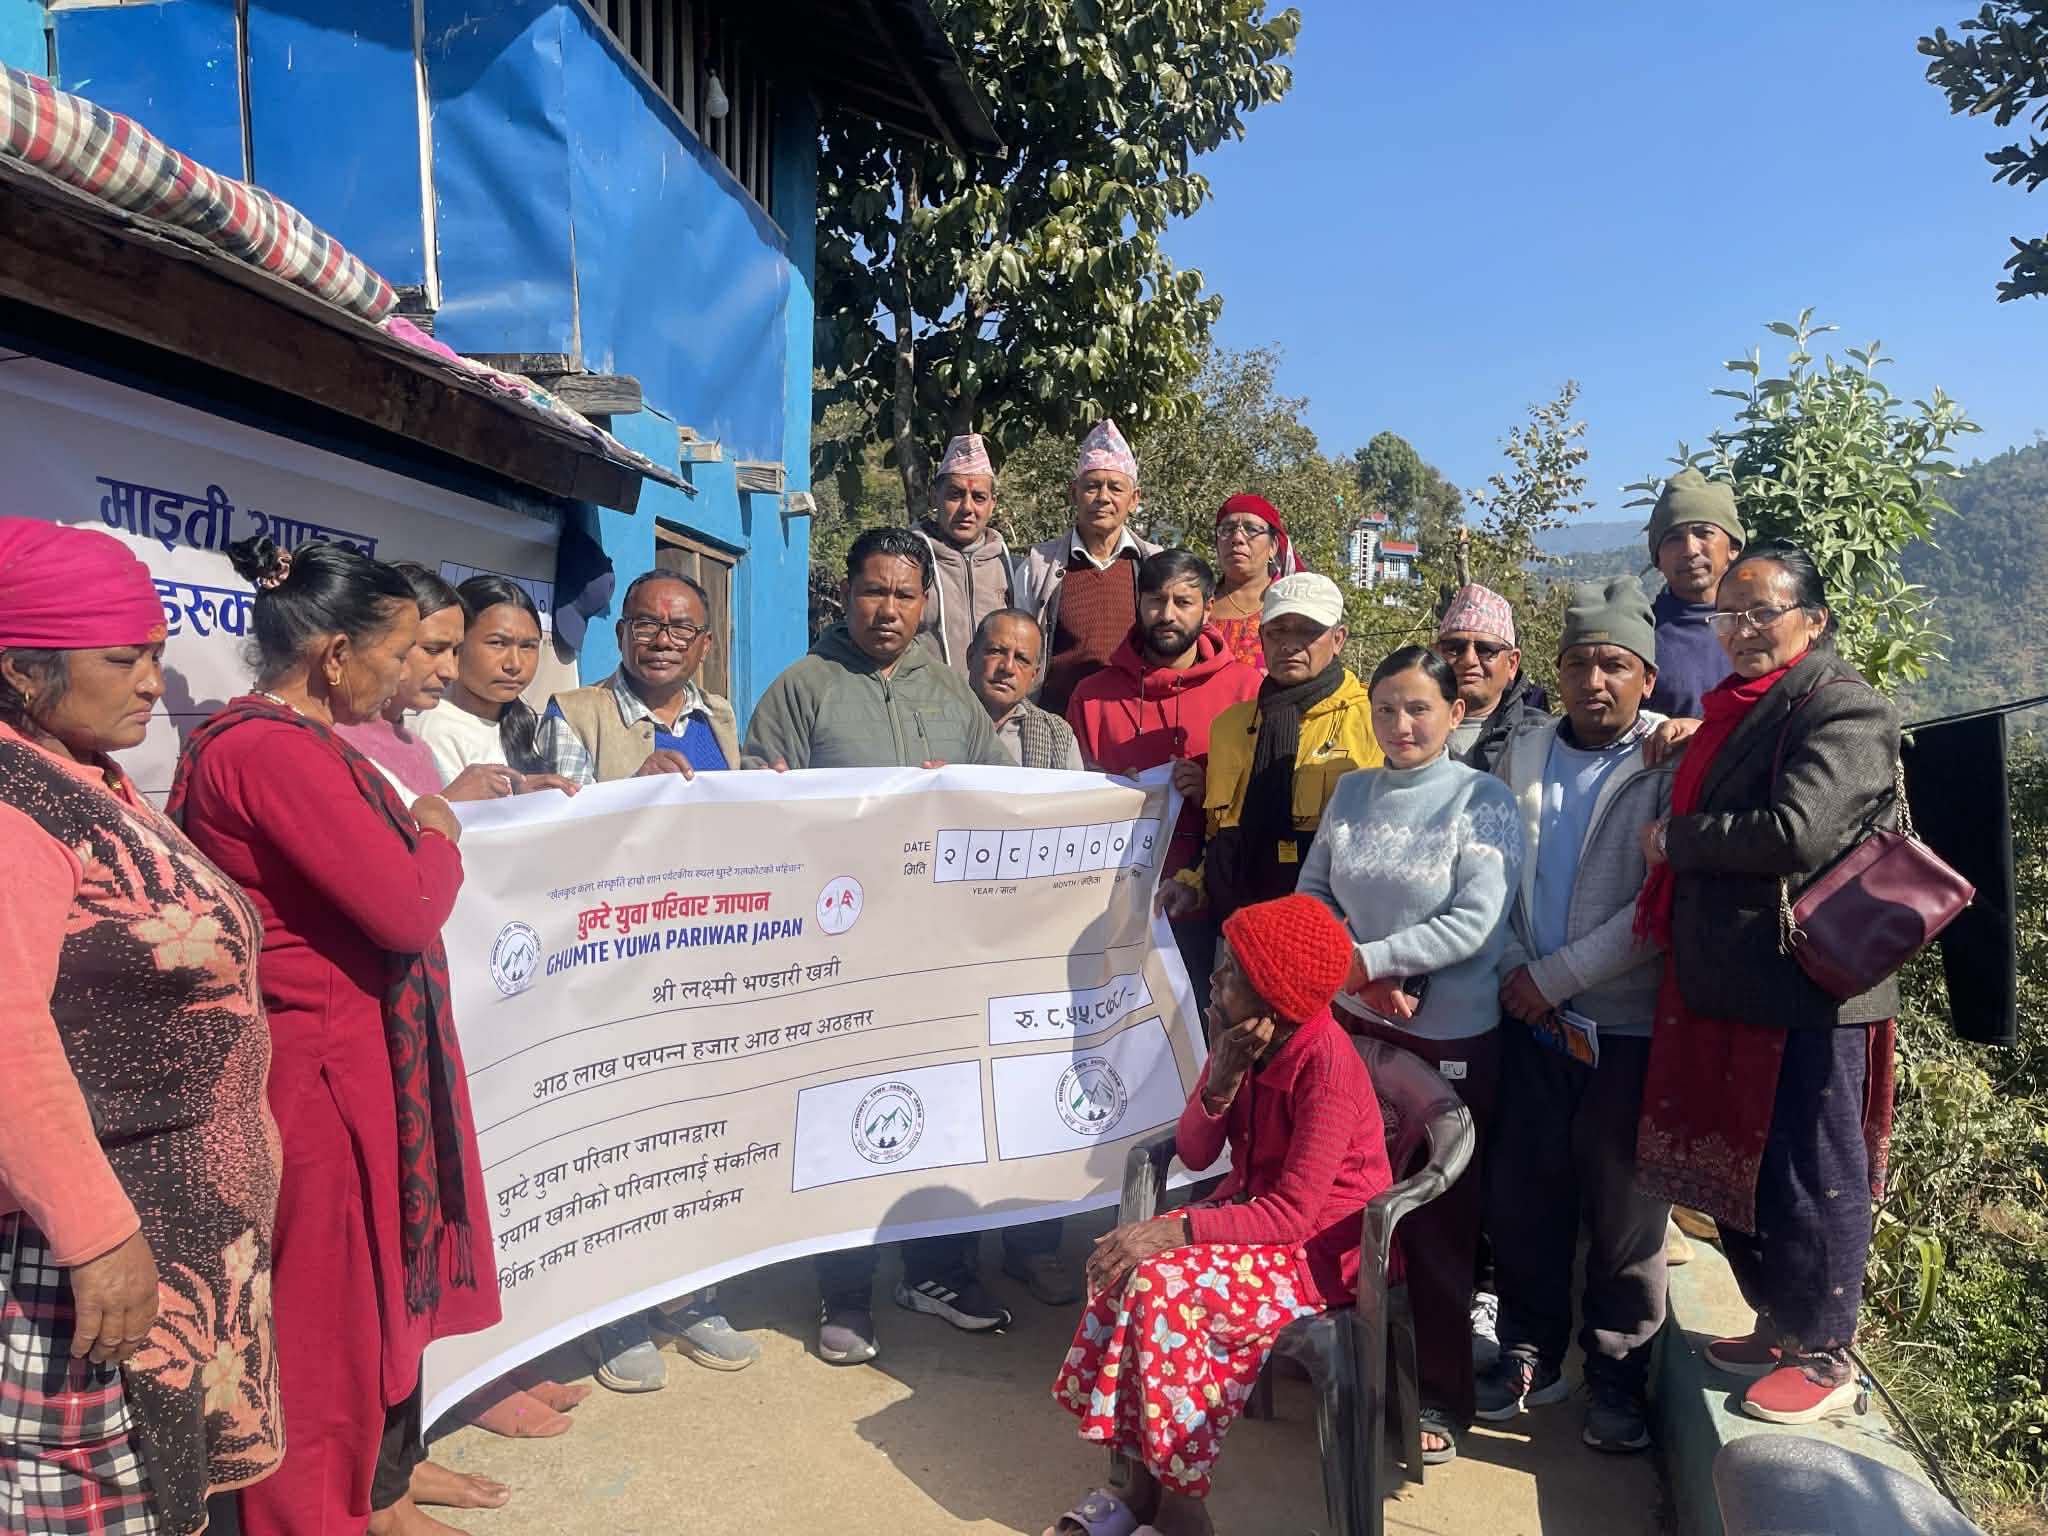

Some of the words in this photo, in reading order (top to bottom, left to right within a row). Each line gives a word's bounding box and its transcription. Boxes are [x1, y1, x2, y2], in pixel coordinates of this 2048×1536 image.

[904, 841, 931, 853] DATE
[577, 902, 612, 940] घुम्टे
[615, 903, 650, 934] युवा
[652, 892, 710, 921] परिवार
[713, 891, 771, 914] जापान
[973, 887, 994, 895] YEAR
[546, 941, 609, 976] GHUMTE
[614, 930, 661, 959] YUWA
[666, 924, 748, 950] PARIWAR
[752, 918, 803, 945] JAPAN
[652, 978, 676, 1003] श्री
[682, 972, 738, 1000] लक्ष्मी
[743, 963, 802, 991] भण्डारी
[806, 956, 842, 980] खत्री
[533, 1072, 568, 1099] आठ
[572, 1058, 616, 1086] लाख
[623, 1043, 688, 1071] पचपन्न
[692, 1036, 739, 1060] हजार
[745, 1029, 780, 1050] आठ
[785, 1021, 813, 1042] सय
[816, 1009, 874, 1035] अठहत्तर
[497, 1174, 530, 1218] घुम्टे
[533, 1162, 568, 1200] युवा
[573, 1142, 631, 1175] परिवार
[634, 1120, 728, 1154] जापानद्वारा
[499, 1215, 541, 1252] श्याम
[545, 1184, 610, 1227] खत्रीको
[614, 1153, 708, 1200] परिवारलाई
[713, 1142, 781, 1175] संकलित
[498, 1260, 535, 1290] र्थिक
[540, 1240, 578, 1273] रकम
[582, 1208, 668, 1255] हस्तान्तरण
[672, 1187, 744, 1221] कार्यक्रम
